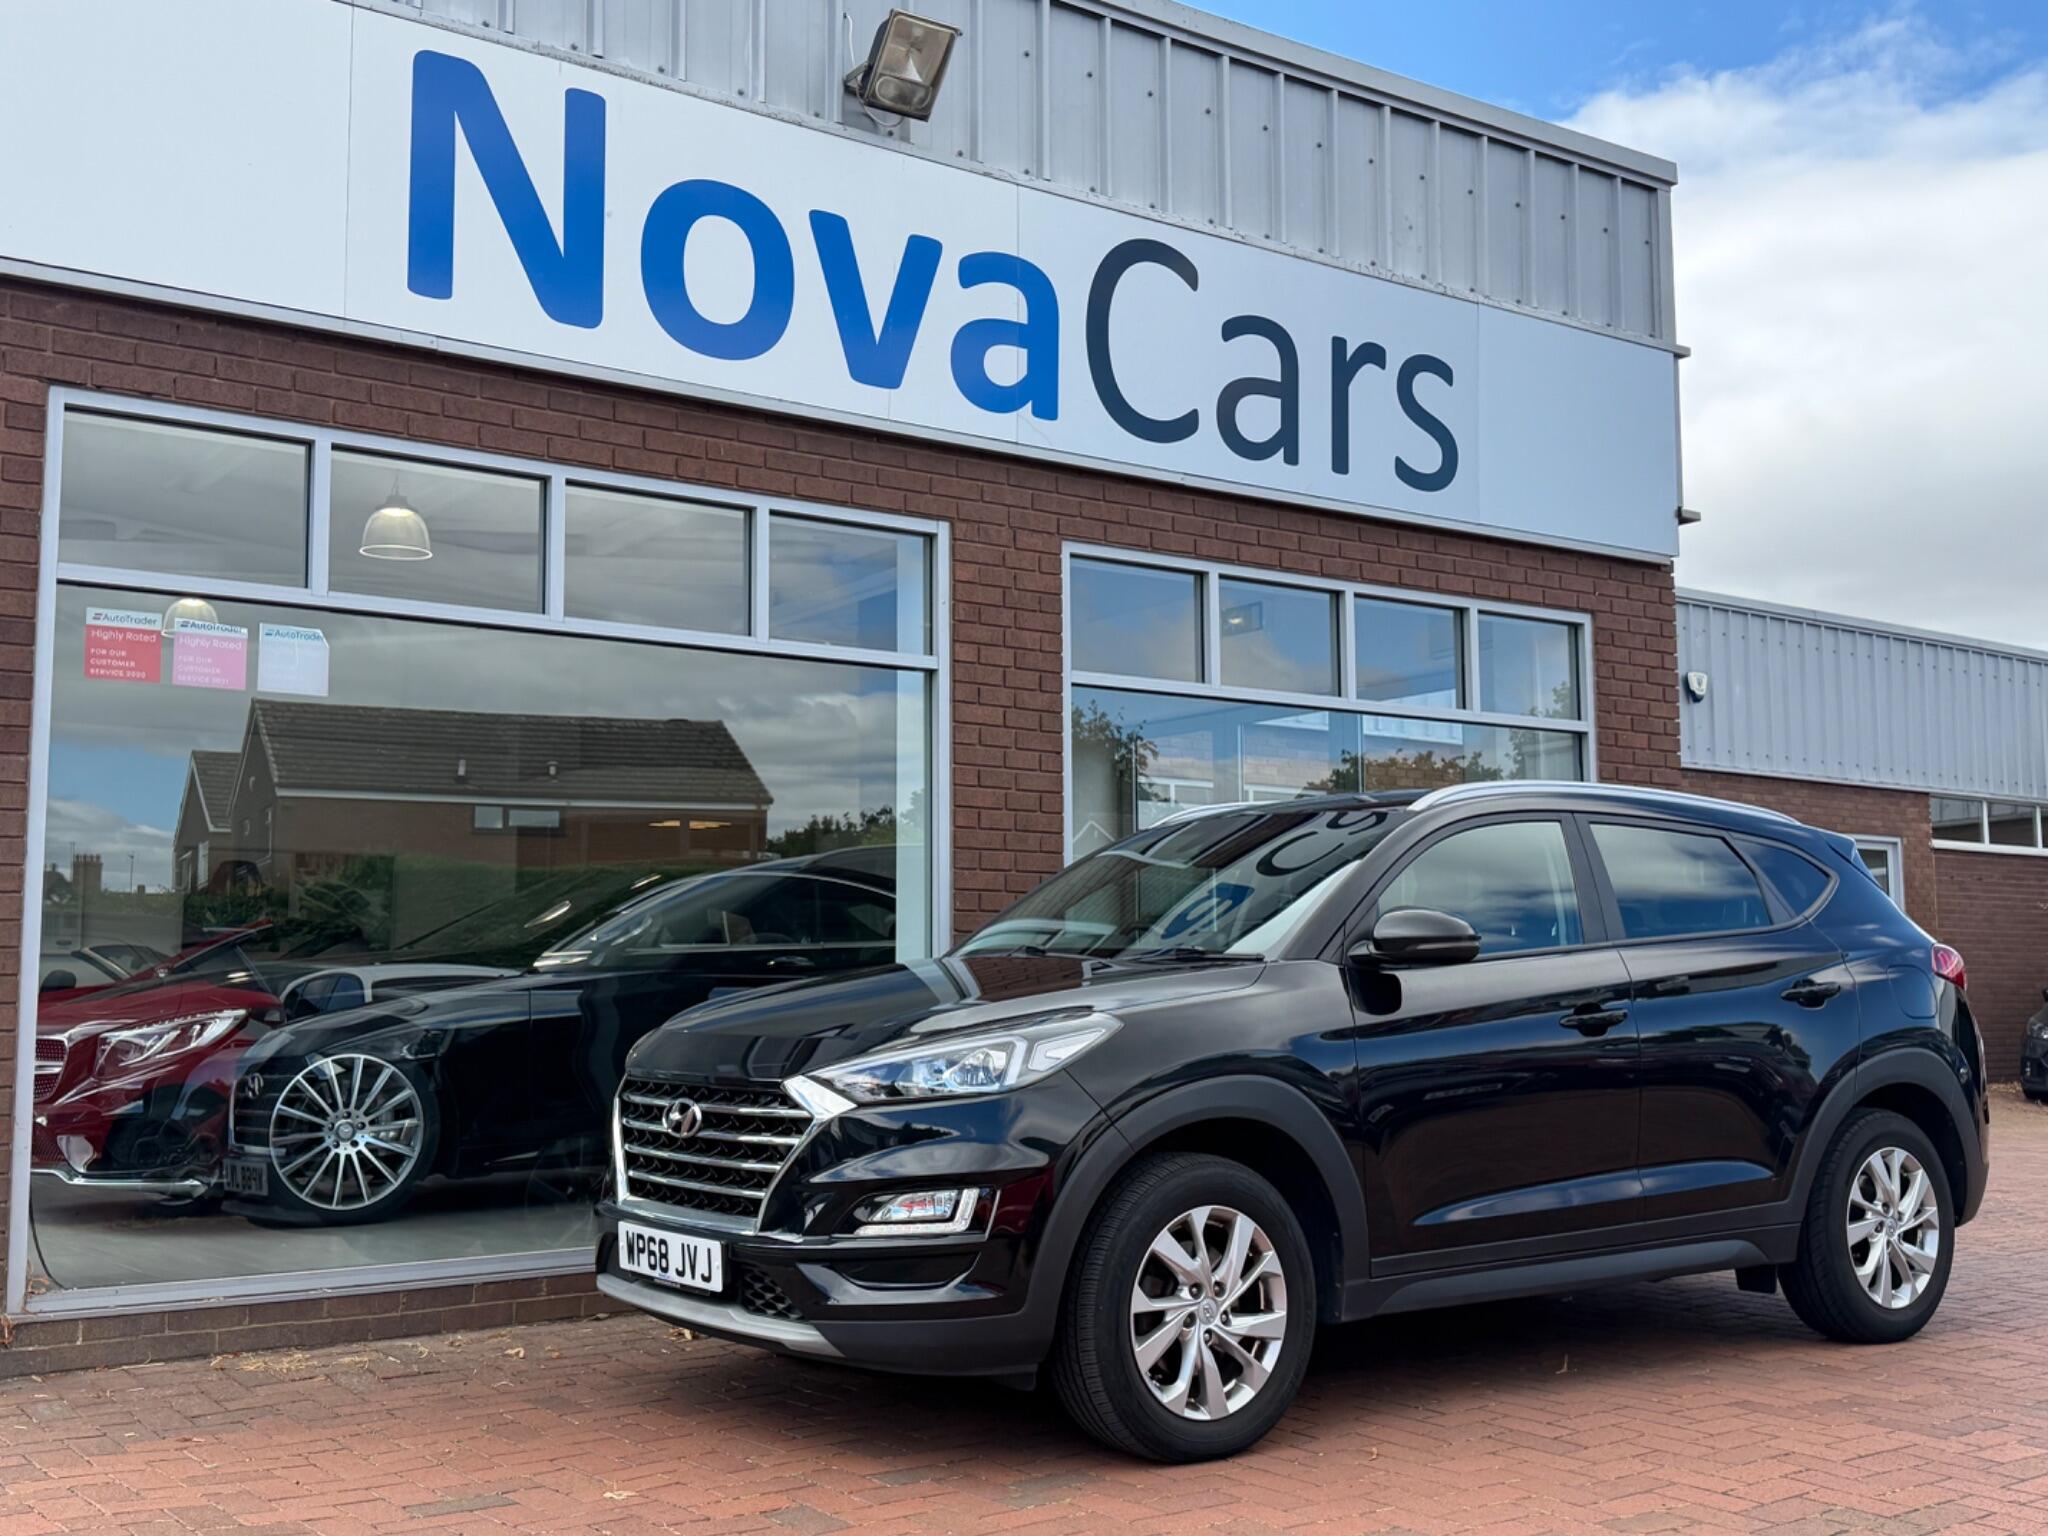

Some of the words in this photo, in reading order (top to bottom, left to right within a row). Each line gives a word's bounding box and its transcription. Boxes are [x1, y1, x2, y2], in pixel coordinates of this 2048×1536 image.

[407, 49, 1460, 494] NovaCars
[102, 613, 158, 626] AutoTrader
[91, 628, 123, 643] Highly
[126, 631, 157, 643] Rated
[178, 635, 210, 649] Highly
[212, 639, 242, 651] Rated
[109, 648, 127, 657] OUR
[90, 658, 136, 668] CUSTOMER
[90, 668, 124, 677] SERVICE
[626, 1230, 669, 1274] WP68
[675, 1242, 712, 1283] JVJ
